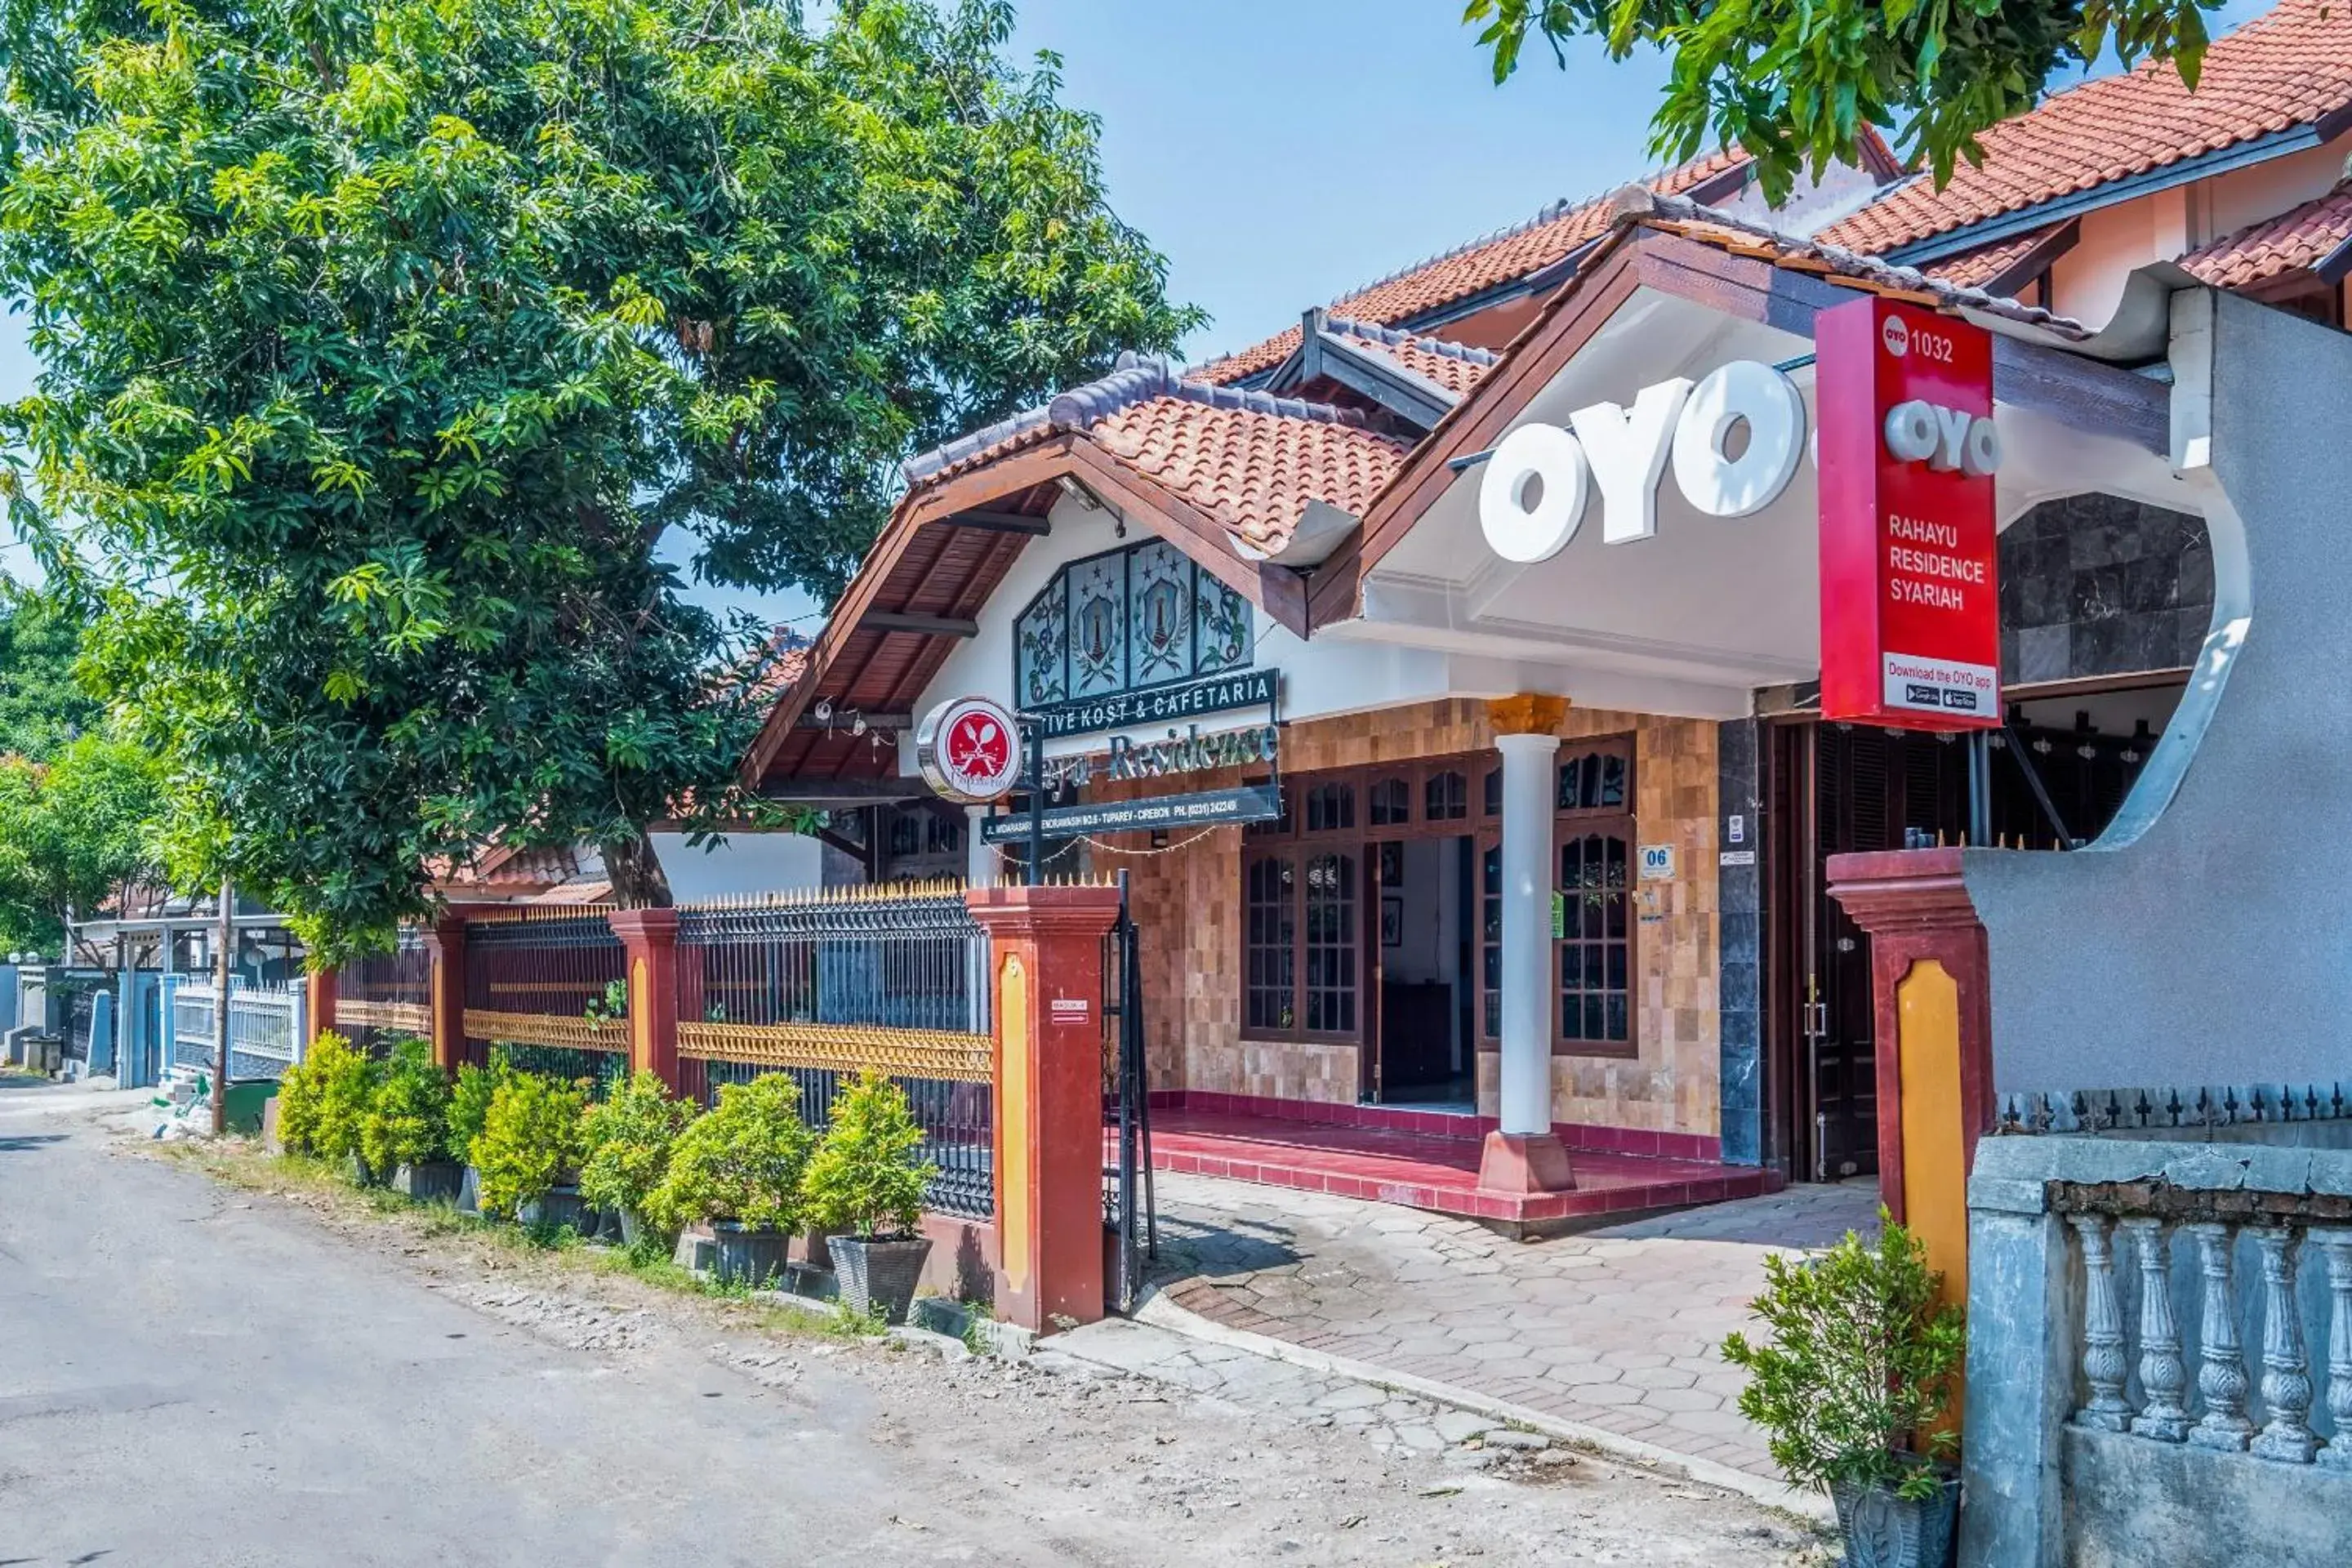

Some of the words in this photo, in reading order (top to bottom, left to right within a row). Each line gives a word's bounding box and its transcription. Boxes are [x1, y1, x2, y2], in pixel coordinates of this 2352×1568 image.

[1886, 328, 1905, 342] OYO
[1912, 329, 1953, 363] 1032
[1885, 399, 2004, 477] OYO
[1479, 360, 1806, 564] OYO
[1890, 514, 1957, 548] RAHAYU
[1891, 546, 1984, 584] RESIDENCE
[1891, 578, 1963, 611] SYARIAH
[1889, 662, 1934, 680] Download
[1936, 670, 1951, 683] the
[1953, 670, 1973, 685] OYO
[1975, 676, 1991, 689] app
[1081, 703, 1126, 727] KOST
[1137, 701, 1145, 718] &
[1154, 679, 1267, 715] CAFETARIA
[1138, 808, 1169, 820] CIREBON
[1647, 849, 1666, 866] 06
